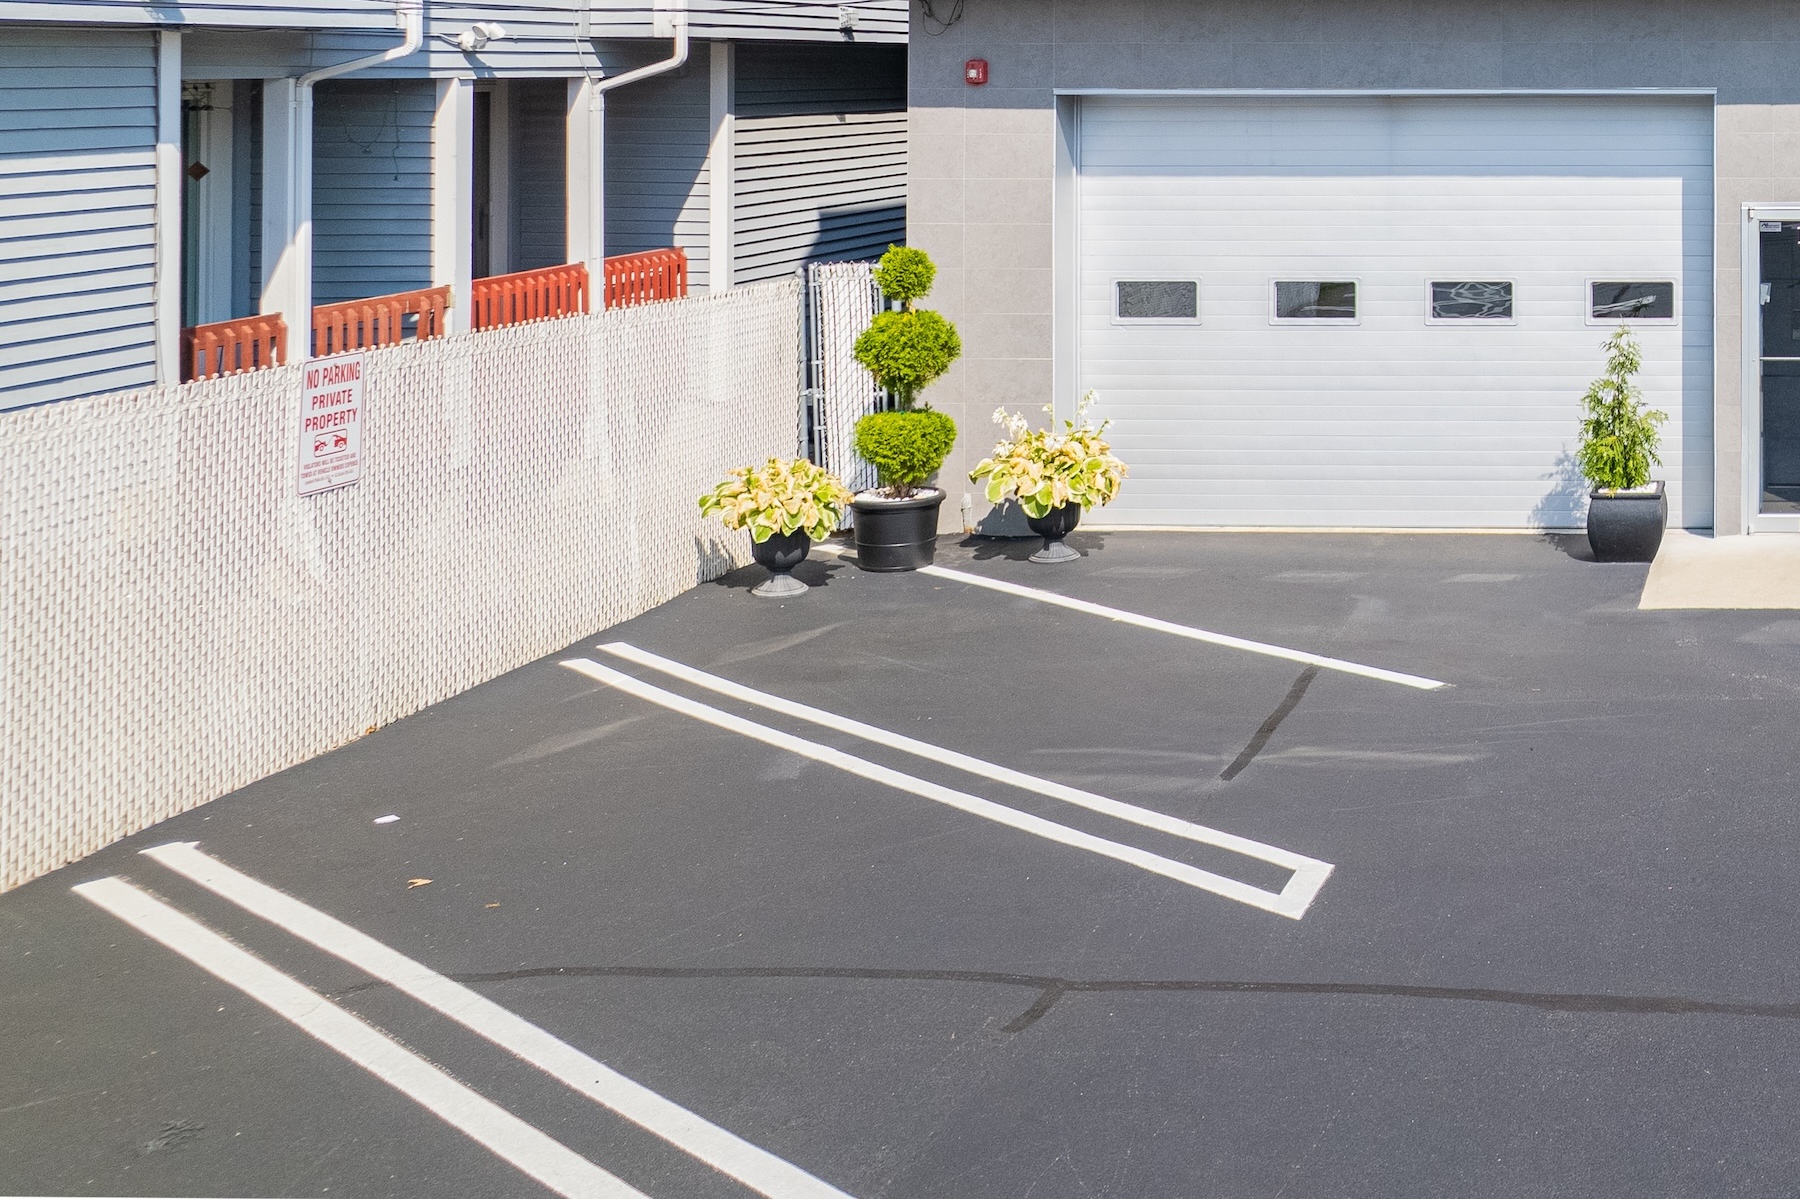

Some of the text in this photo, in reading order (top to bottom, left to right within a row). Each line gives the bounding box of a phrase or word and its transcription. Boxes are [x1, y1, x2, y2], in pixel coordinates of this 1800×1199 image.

[307, 361, 360, 390] NO PARKING
[312, 389, 353, 410] PRIVATE
[305, 408, 358, 433] PROPERTY
